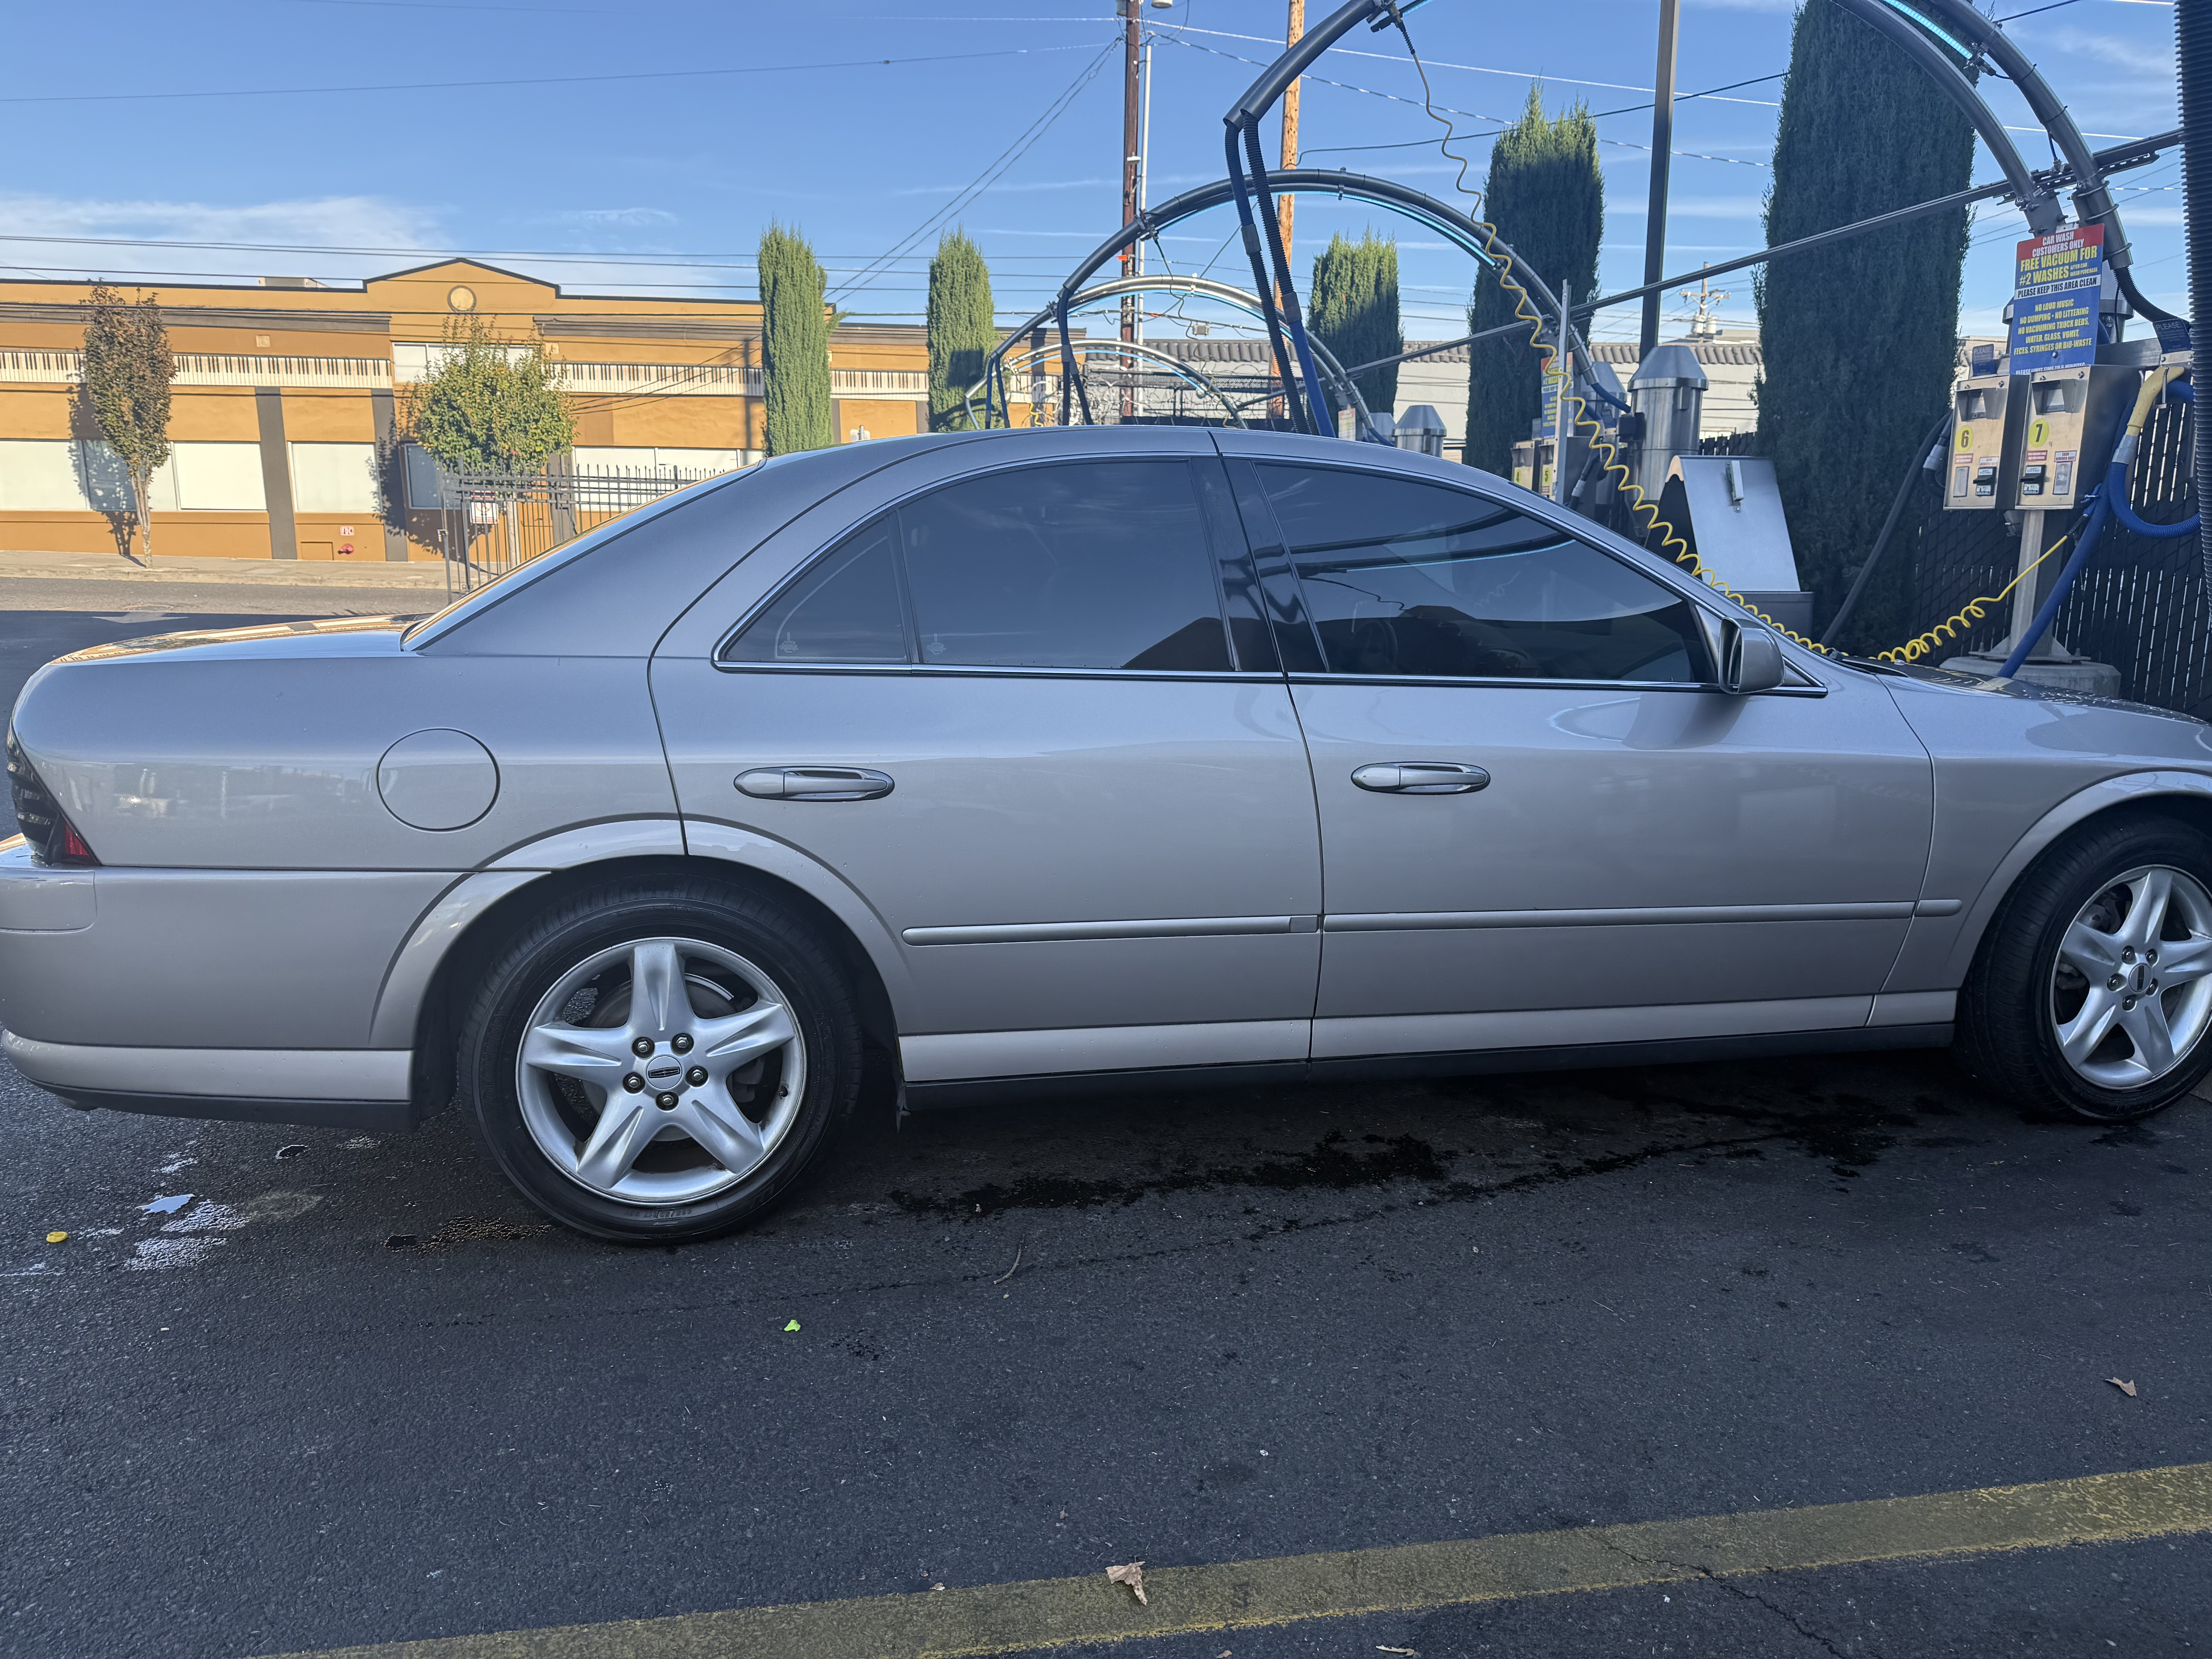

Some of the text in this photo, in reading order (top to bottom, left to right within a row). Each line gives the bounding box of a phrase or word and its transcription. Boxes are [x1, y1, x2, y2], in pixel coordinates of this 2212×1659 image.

[2043, 231, 2074, 246] CAR WASH
[2032, 239, 2084, 257] CUSTOMERS ONLY
[2021, 246, 2097, 272] FREE VACUUM FOR
[2020, 266, 2069, 286] #2 WASHES
[2018, 277, 2097, 298] PLEASE KEEP THIS AREA CLEAN
[2043, 302, 2056, 311] LOUD
[2057, 299, 2074, 309] MUSIC
[2028, 313, 2051, 323] DUMPING
[2063, 307, 2089, 317] LITTERING
[2026, 322, 2056, 333] VACUUMING
[2057, 320, 2073, 329] TRUCK
[2030, 344, 2054, 353] SYRINGES
[2063, 338, 2092, 349] BIO-WASTE
[1961, 430, 1969, 448] 6
[2036, 424, 2043, 442] 7
[1545, 471, 1548, 482] 5
